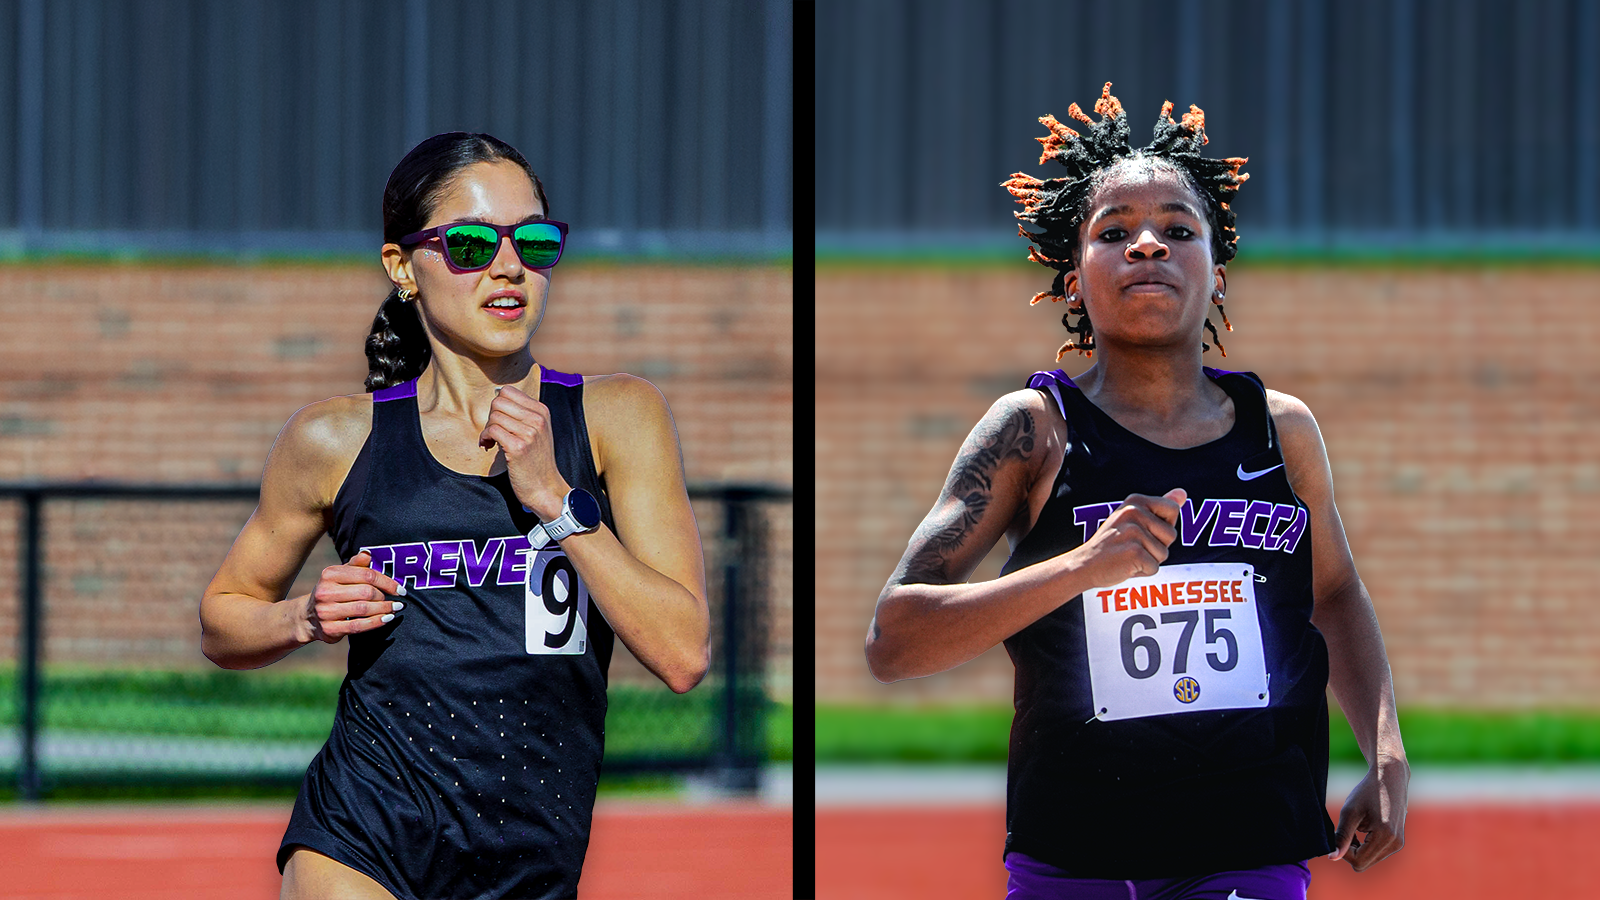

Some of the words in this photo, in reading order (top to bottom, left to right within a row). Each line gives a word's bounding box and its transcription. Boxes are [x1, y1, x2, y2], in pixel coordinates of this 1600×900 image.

[1073, 498, 1307, 554] TVECCA
[360, 535, 531, 590] TREVE
[541, 555, 579, 649] 9
[1096, 580, 1244, 613] TENNESSEE
[1120, 608, 1239, 680] 675
[1174, 677, 1200, 703] SEC
